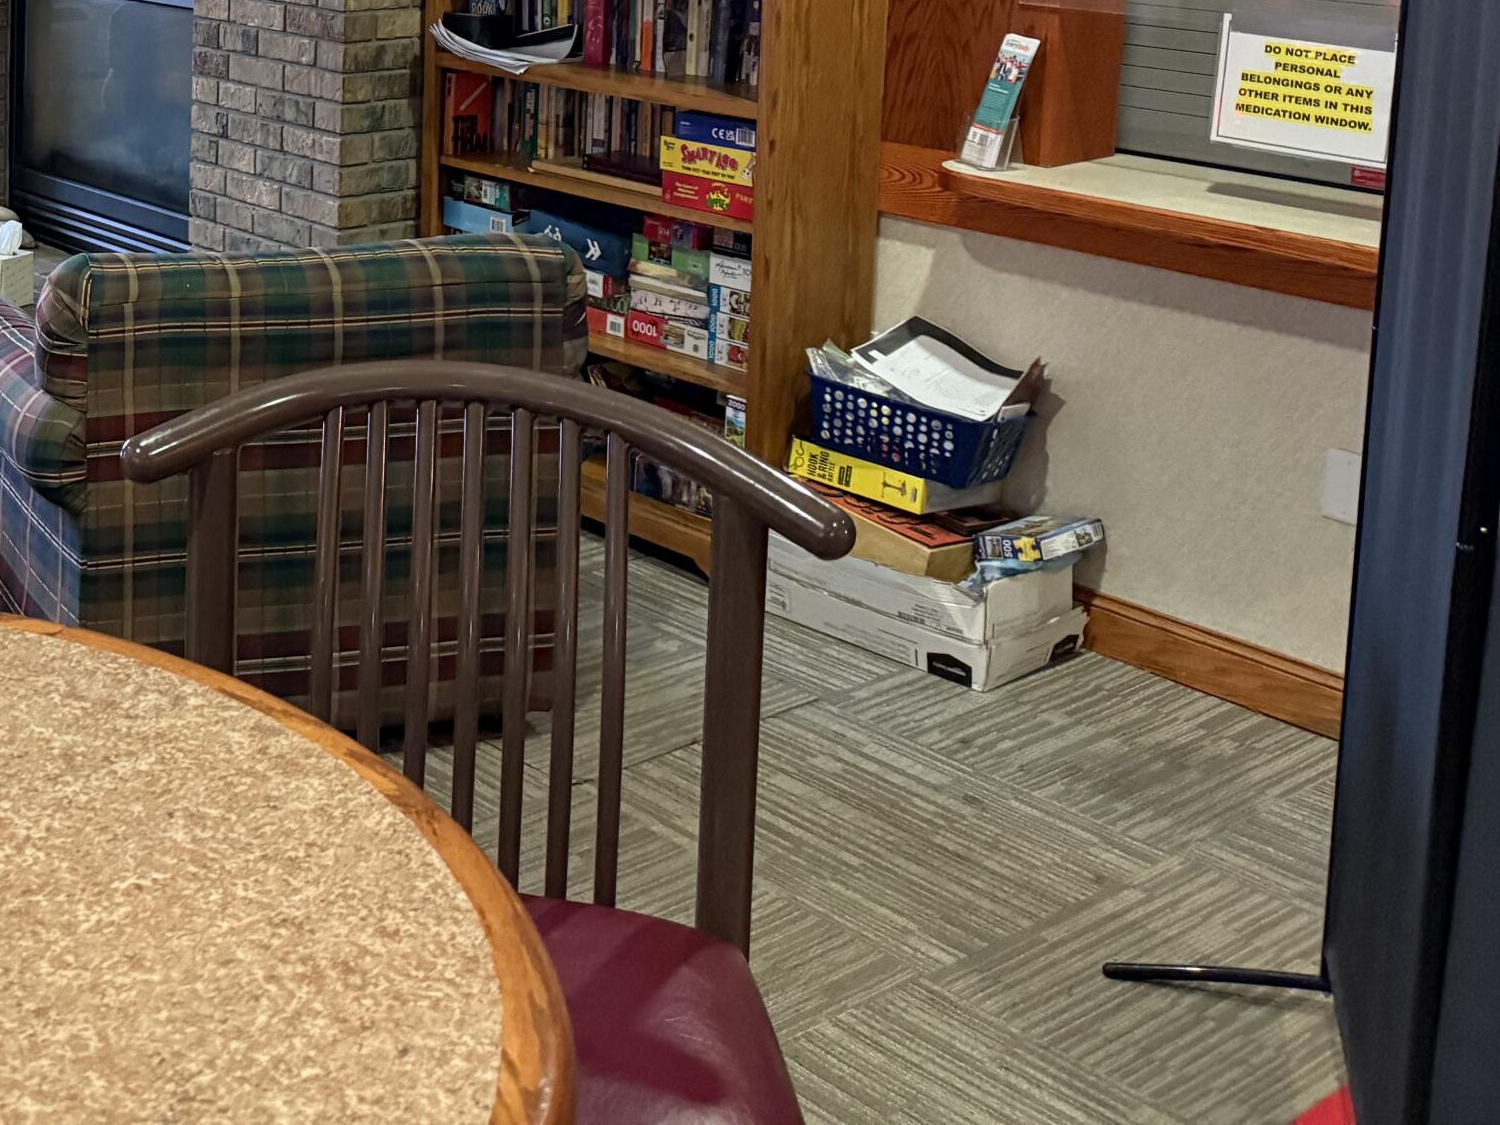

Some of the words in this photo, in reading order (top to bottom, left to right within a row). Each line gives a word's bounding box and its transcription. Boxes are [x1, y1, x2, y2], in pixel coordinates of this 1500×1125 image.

[1264, 44, 1282, 55] DO
[1285, 47, 1312, 59] NOT
[1314, 50, 1356, 65] PLACE
[1274, 61, 1341, 79] PERSONAL
[1241, 72, 1320, 92] BELONGINGS
[1324, 84, 1342, 95] OR
[1346, 87, 1374, 99] ANY
[1238, 87, 1279, 102] OTHER
[1282, 94, 1321, 108] ITEMS
[1324, 100, 1338, 111] IN
[1342, 102, 1373, 115] THIS
[1235, 103, 1311, 122] MEDICATION
[1314, 114, 1372, 132] WINDOW.
[633, 319, 658, 338] 1000
[807, 452, 819, 477] HOOK
[819, 451, 830, 474] RING
[1002, 539, 1013, 558] 500
